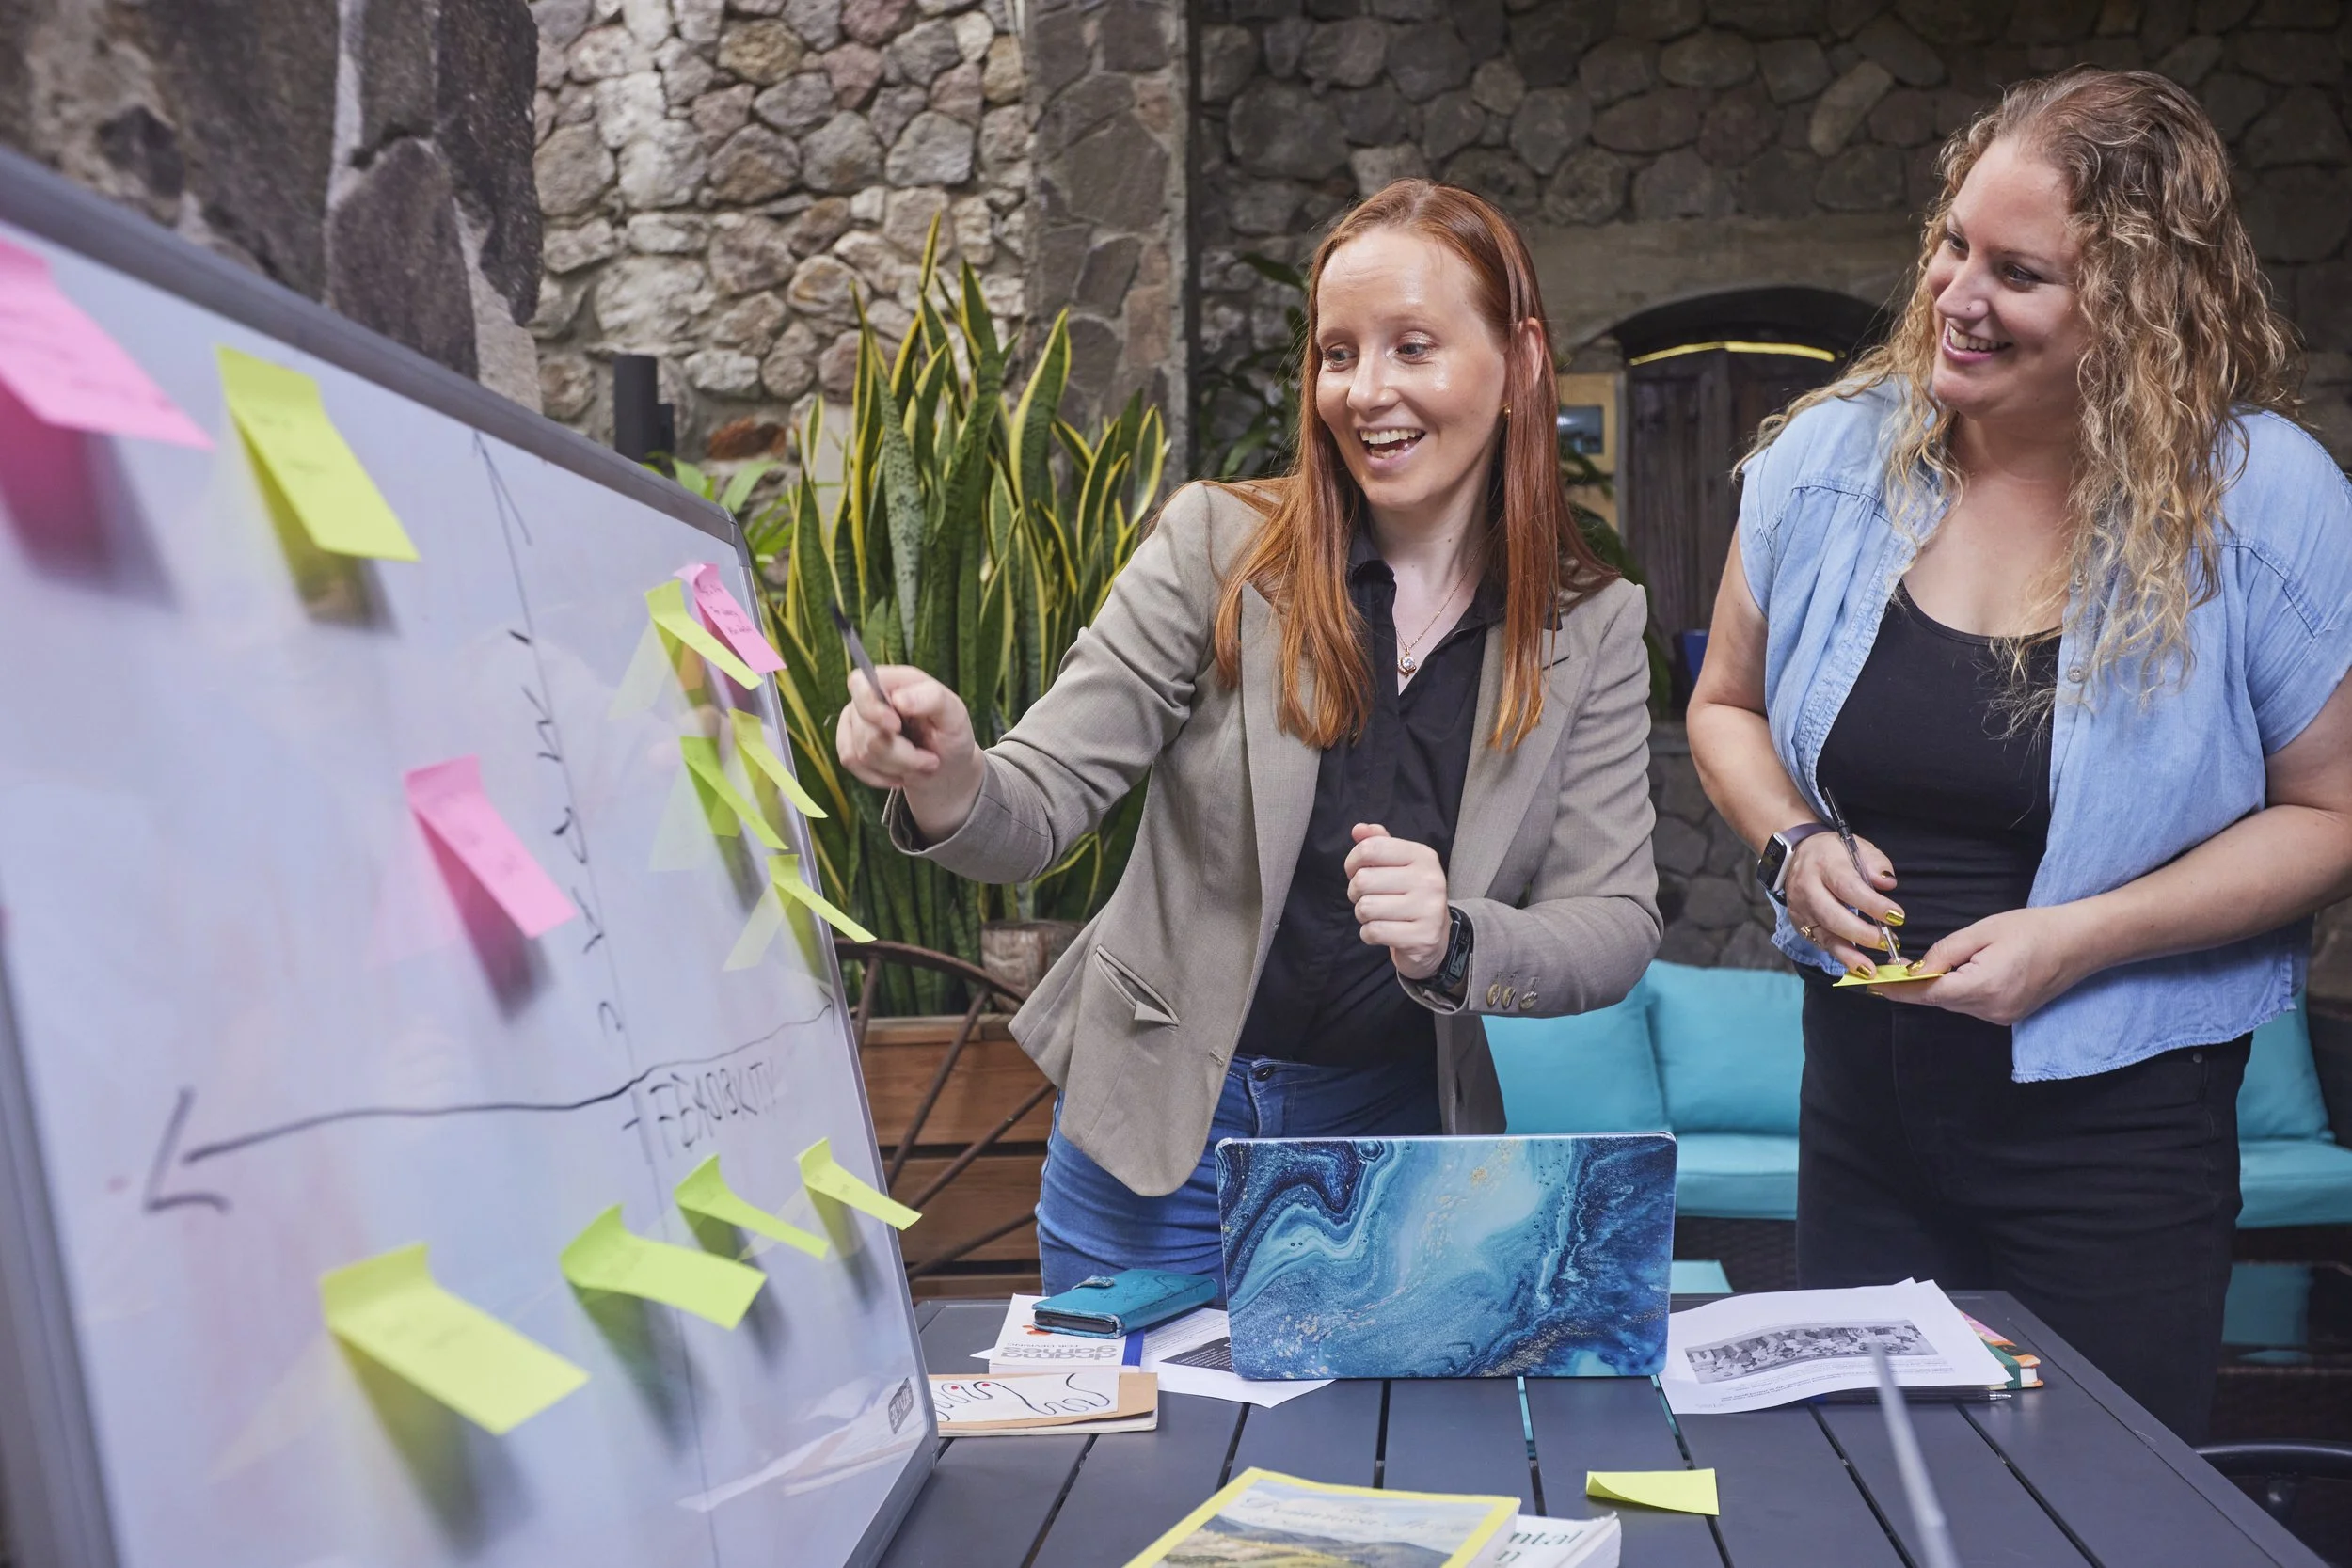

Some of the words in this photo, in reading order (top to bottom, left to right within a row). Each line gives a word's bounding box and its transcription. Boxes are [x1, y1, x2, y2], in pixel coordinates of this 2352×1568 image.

[1001, 1352, 1117, 1360] drama
[1003, 1345, 1117, 1356] games
[1508, 1529, 1584, 1545] ntal
